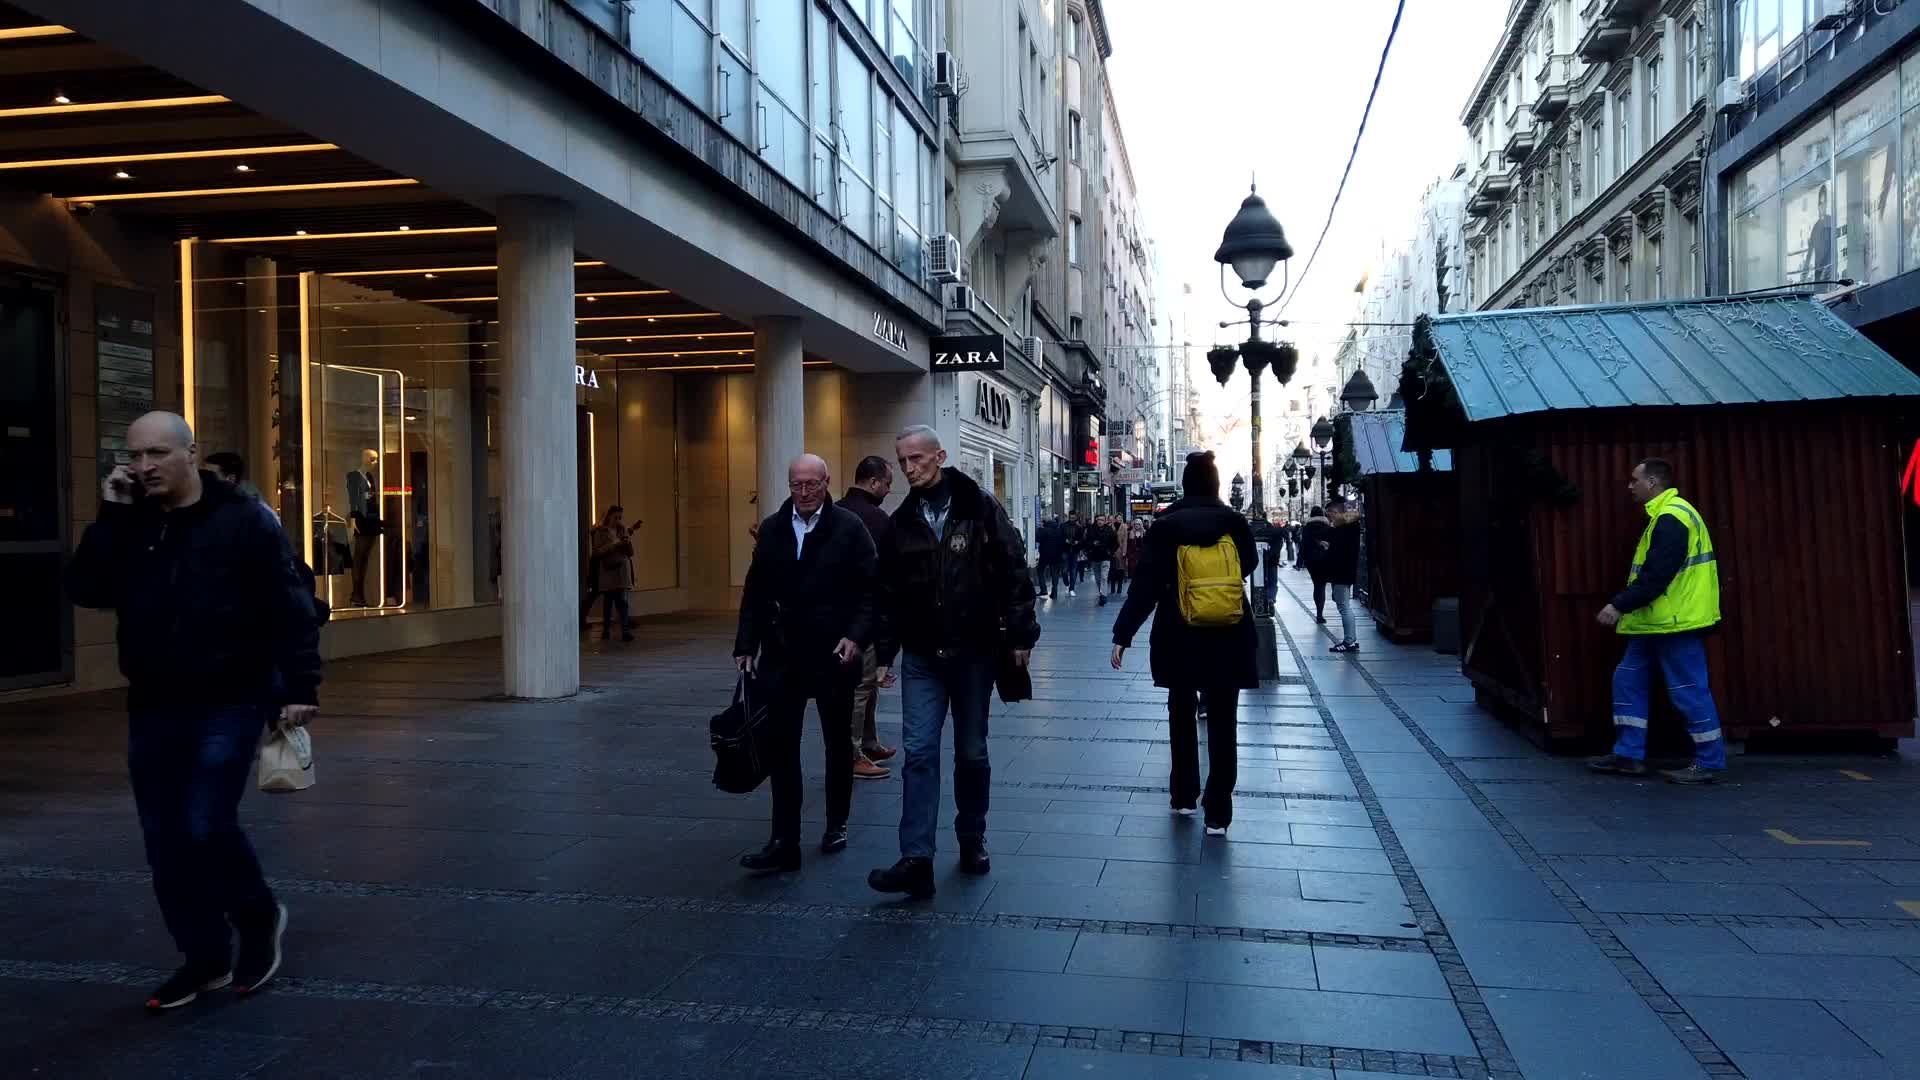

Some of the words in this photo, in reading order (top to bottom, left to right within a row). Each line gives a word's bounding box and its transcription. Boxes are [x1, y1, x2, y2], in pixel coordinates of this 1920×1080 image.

[872, 311, 908, 351] ZARA
[935, 351, 1000, 365] ZARA
[575, 364, 600, 389] RA
[975, 379, 1012, 430] ALDO
